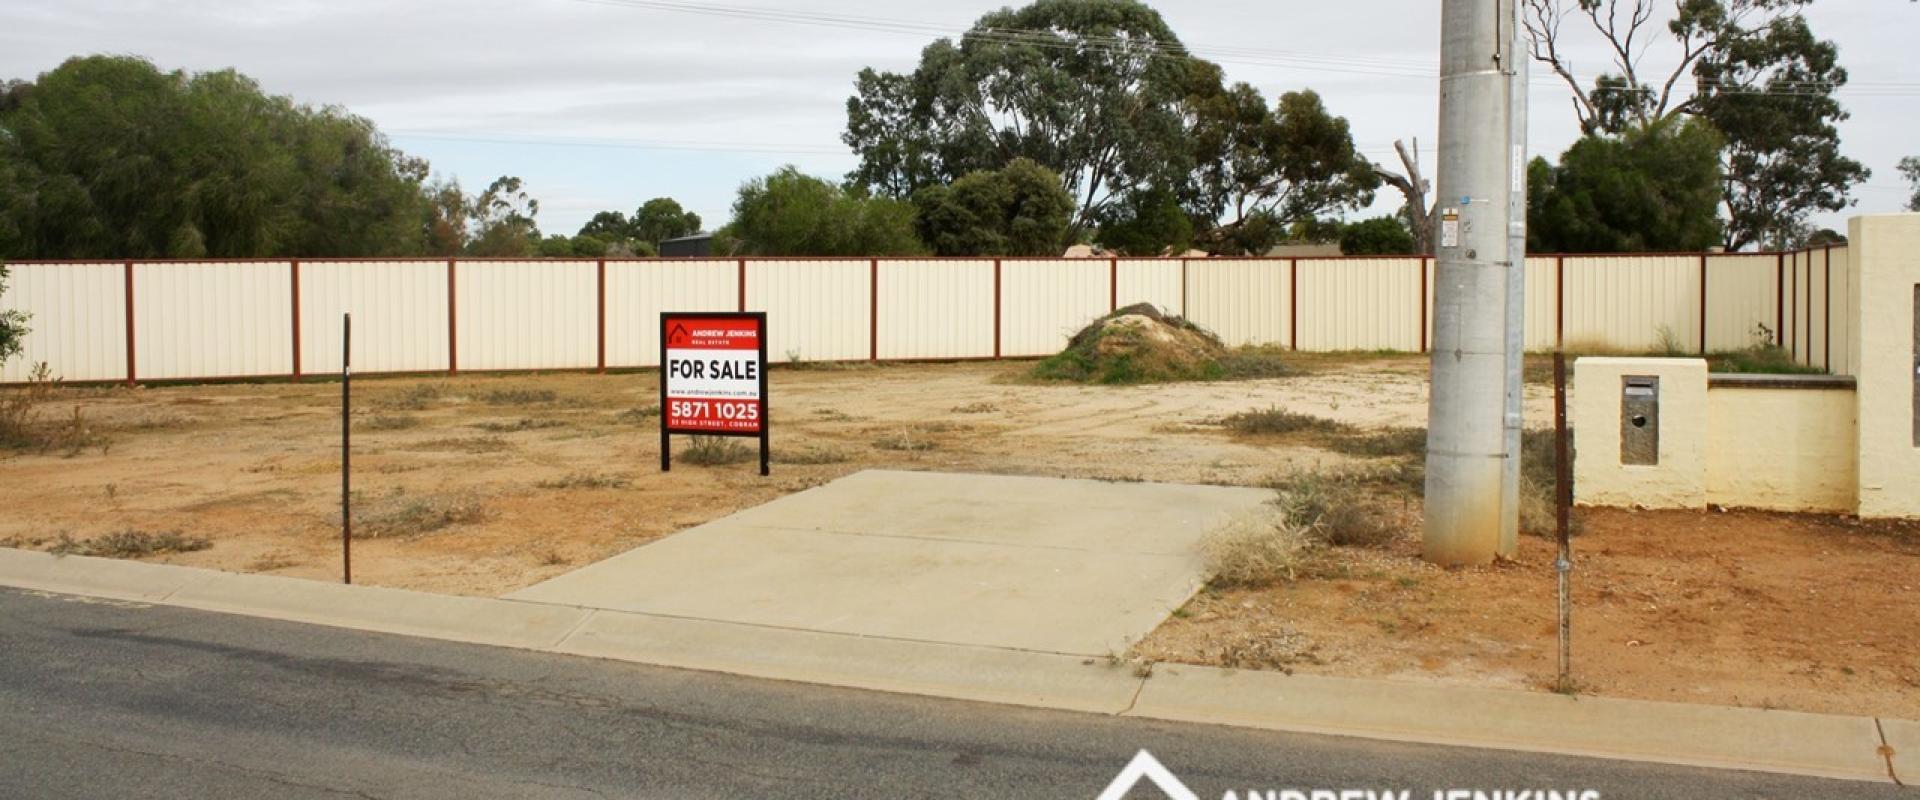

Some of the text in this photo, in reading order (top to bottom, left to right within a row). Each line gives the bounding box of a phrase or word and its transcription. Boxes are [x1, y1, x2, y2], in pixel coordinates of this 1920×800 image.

[725, 329, 757, 337] JENKINS
[670, 359, 757, 380] FOR SALE
[671, 401, 758, 420] 5871 1025
